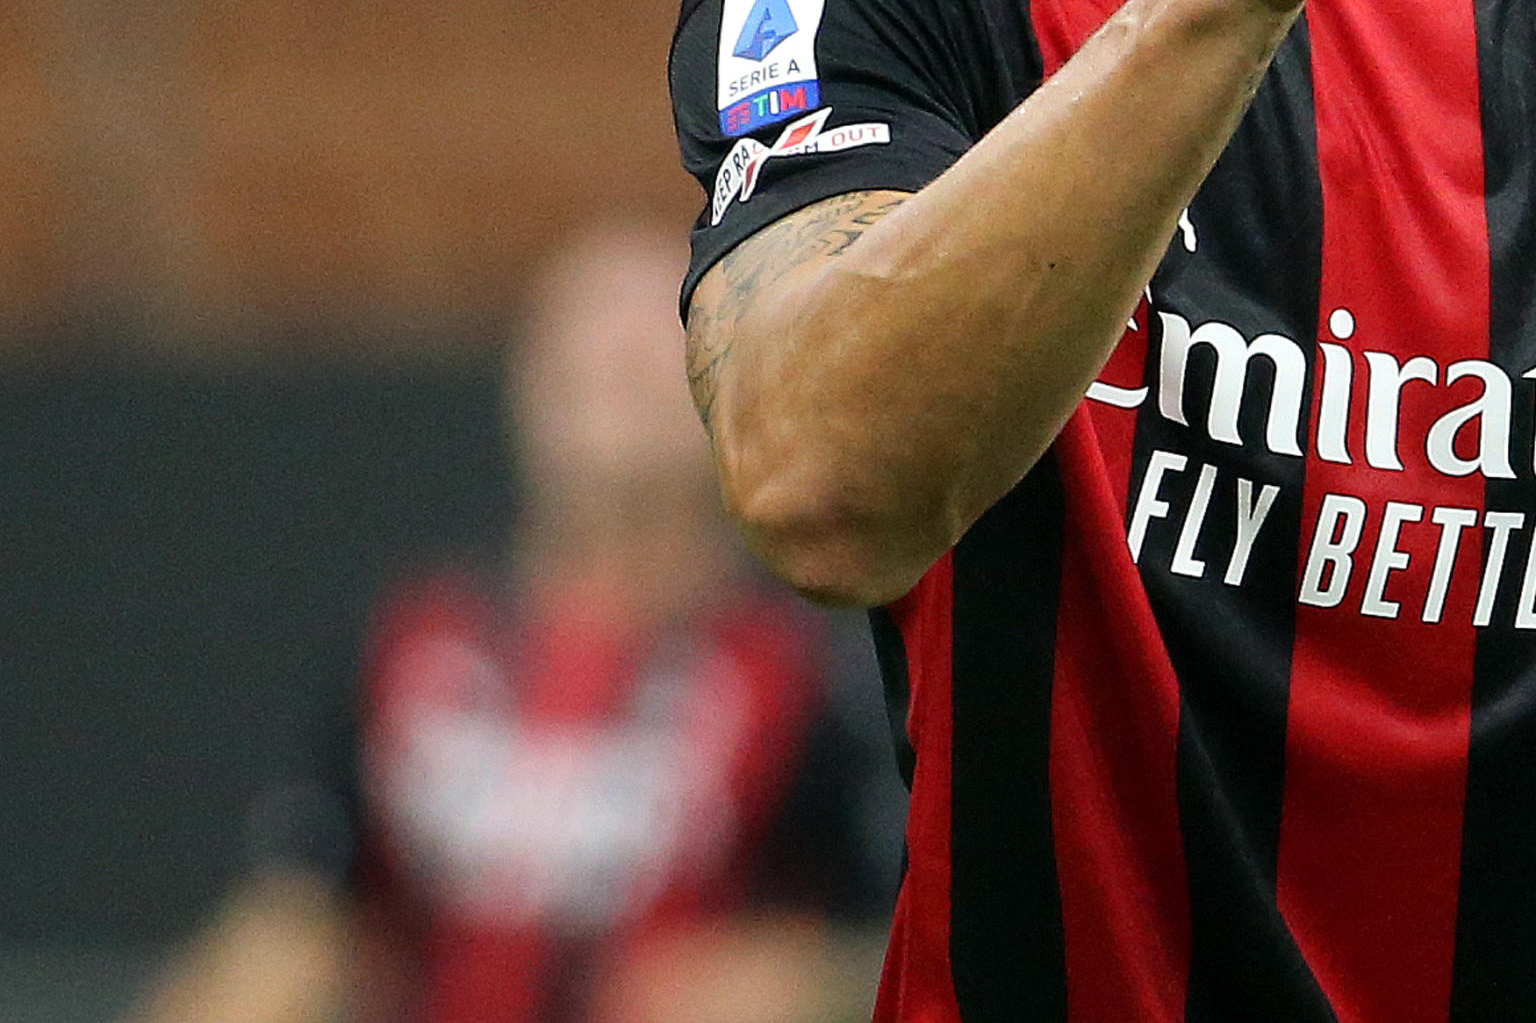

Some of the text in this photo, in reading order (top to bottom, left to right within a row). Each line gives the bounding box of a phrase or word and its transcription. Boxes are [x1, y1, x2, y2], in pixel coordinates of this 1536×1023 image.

[729, 58, 801, 97] SERIE A
[752, 87, 807, 118] TIM
[831, 126, 880, 147] OUT
[1127, 449, 1281, 587] FLY
